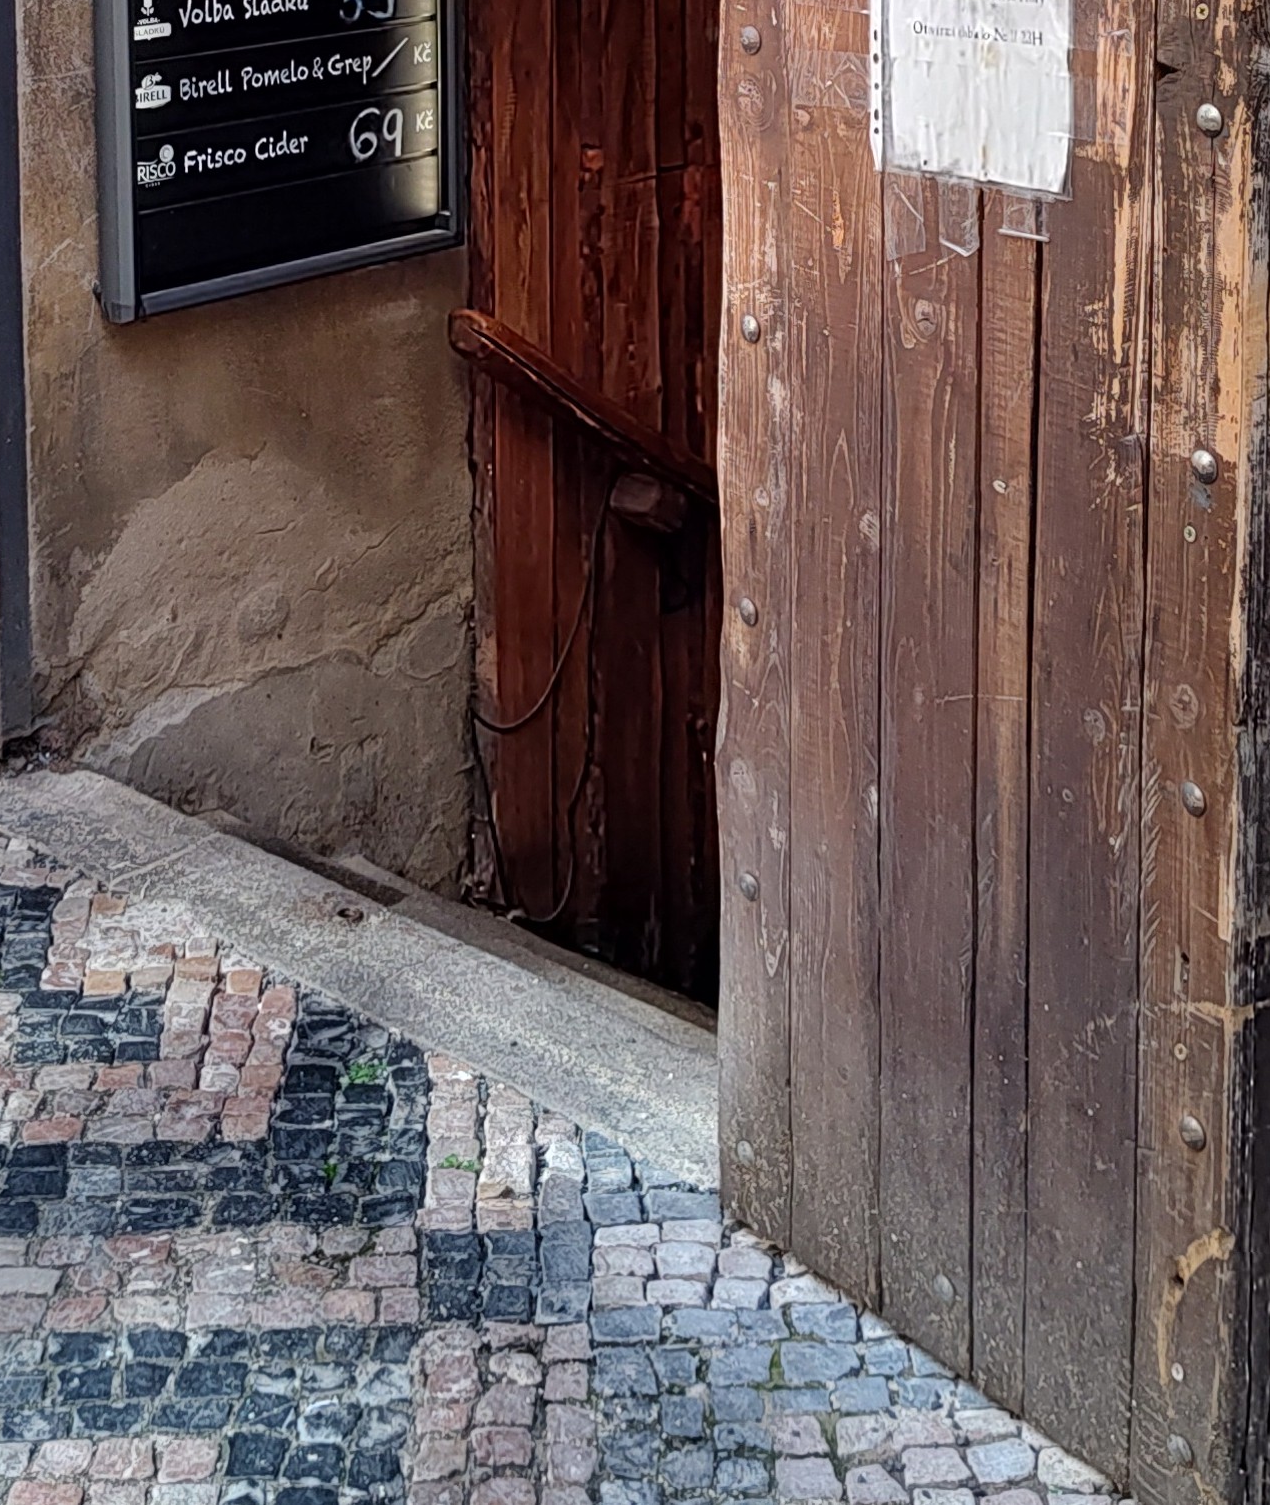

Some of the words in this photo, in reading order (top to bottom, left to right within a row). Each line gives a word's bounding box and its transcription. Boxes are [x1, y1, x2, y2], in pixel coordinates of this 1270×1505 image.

[136, 89, 167, 103] IRELL
[179, 70, 233, 100] Birell
[241, 59, 309, 91] Pomelo
[312, 57, 324, 79] &
[328, 54, 372, 84] Grep
[413, 44, 432, 64] Kč
[183, 145, 247, 173] Frisco
[254, 130, 309, 160] Cider
[349, 107, 404, 163] 69
[415, 110, 434, 132] Kč
